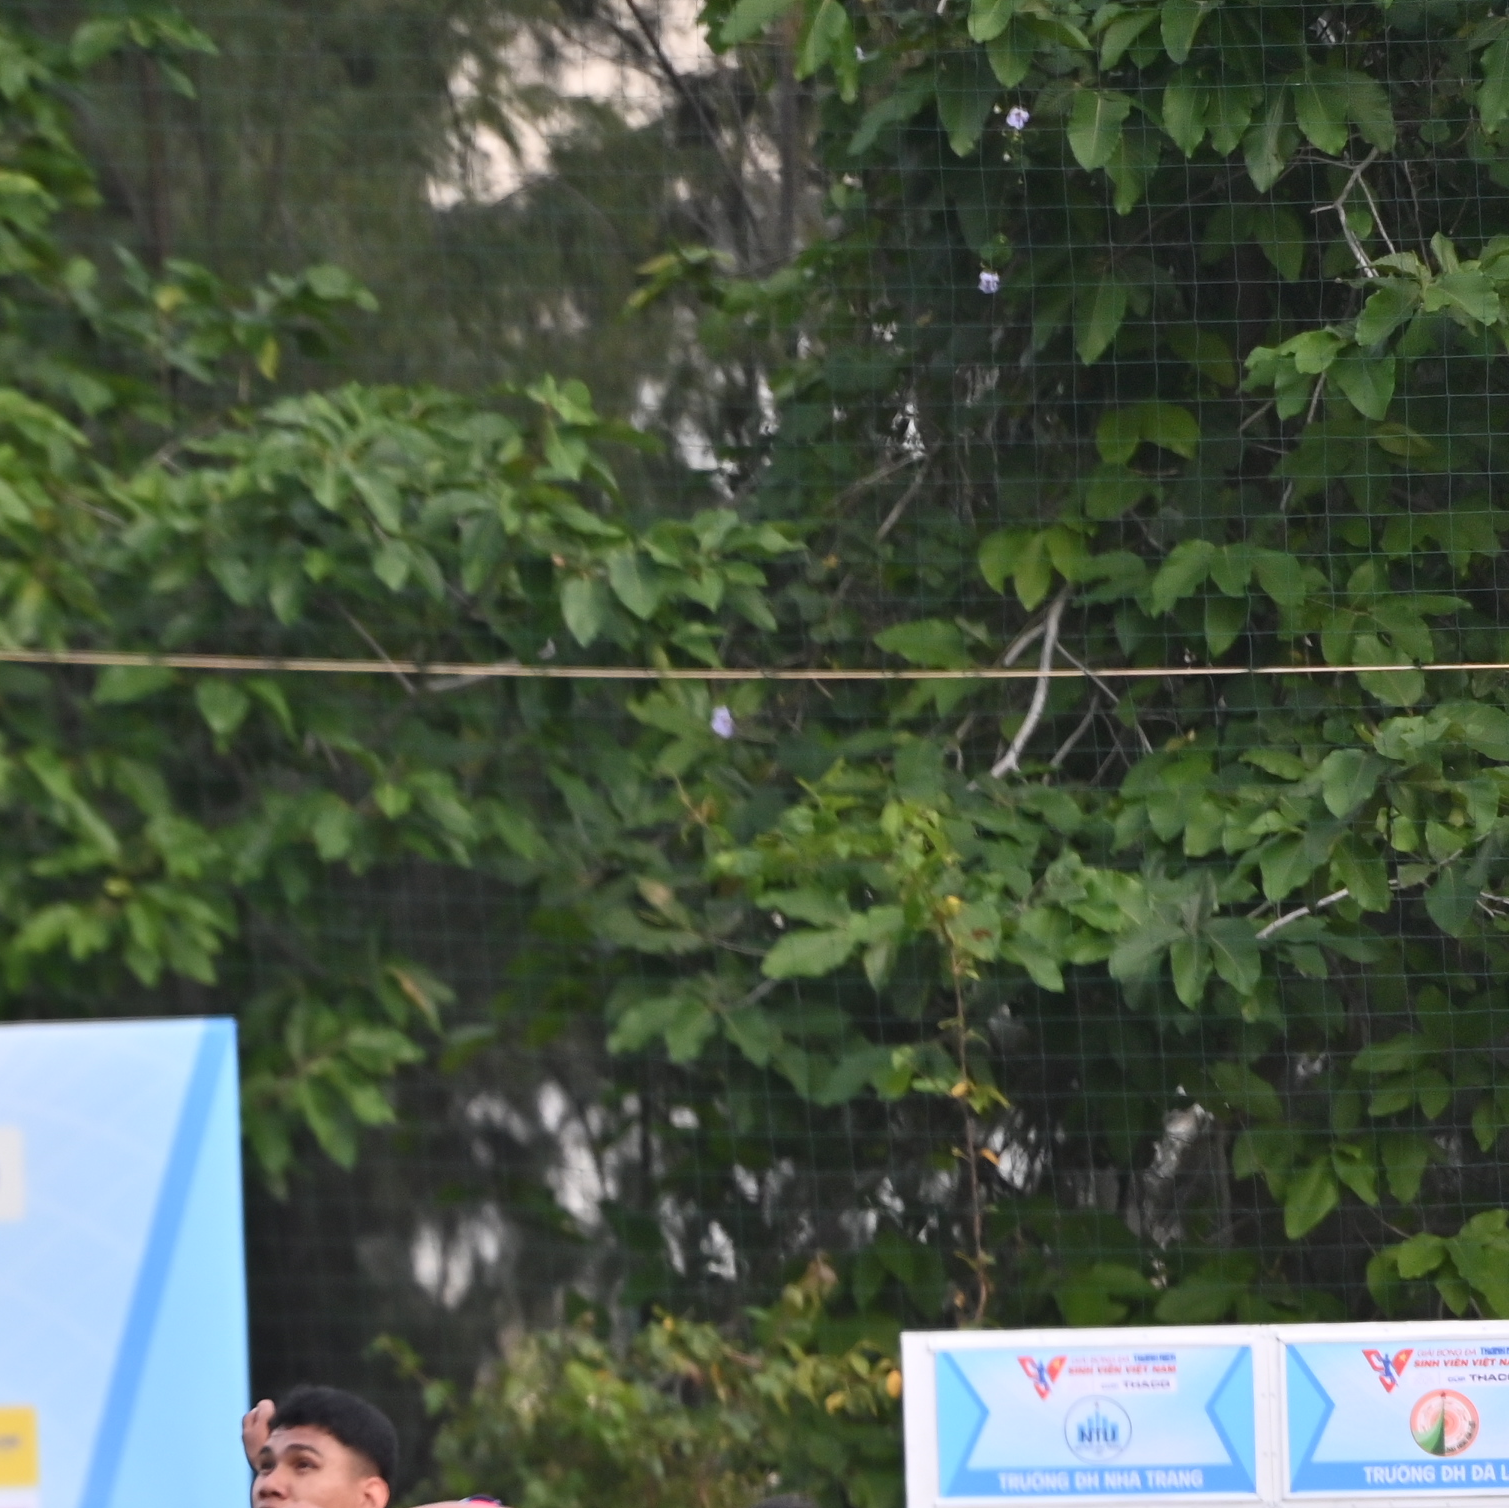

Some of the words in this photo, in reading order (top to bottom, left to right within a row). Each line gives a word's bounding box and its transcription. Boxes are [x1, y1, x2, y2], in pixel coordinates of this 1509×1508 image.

[1414, 1359, 1440, 1368] SINH
[1443, 1357, 1469, 1367] VIÊN
[1472, 1356, 1496, 1368] VIỆT
[1103, 1469, 1142, 1490] NHA
[1145, 1467, 1205, 1489] TRANG
